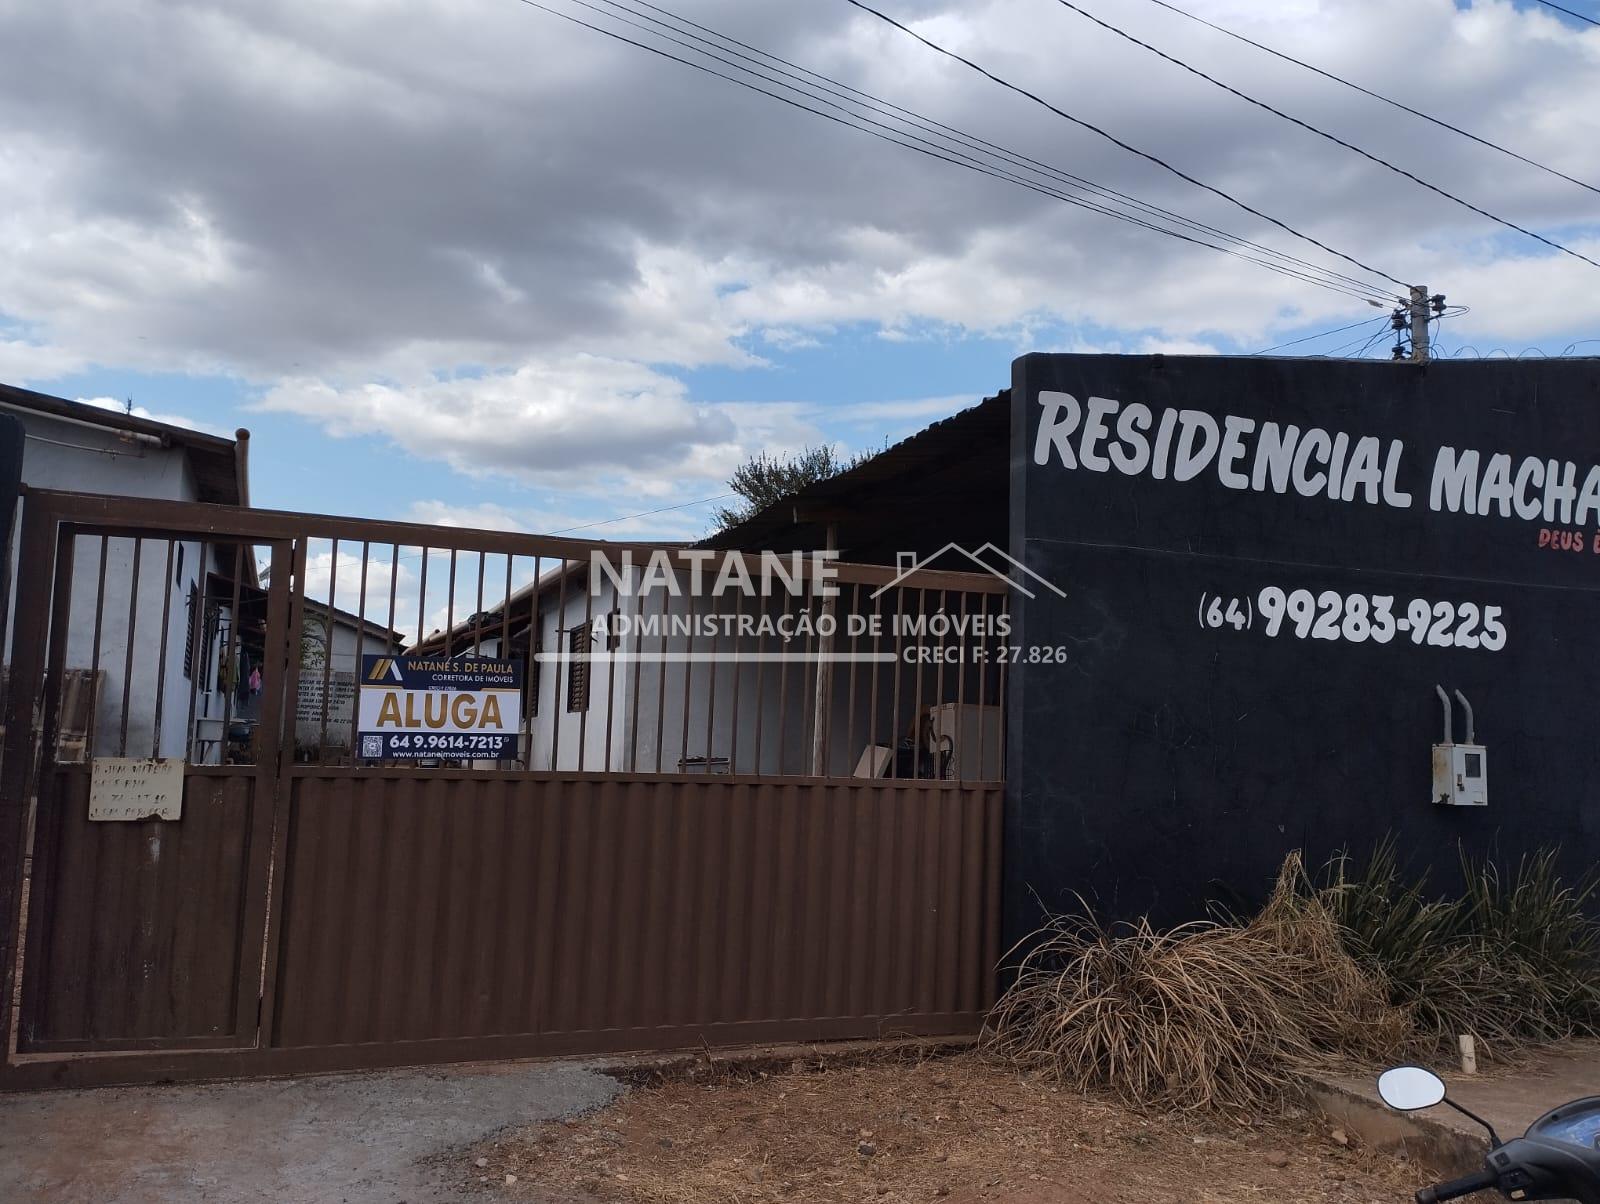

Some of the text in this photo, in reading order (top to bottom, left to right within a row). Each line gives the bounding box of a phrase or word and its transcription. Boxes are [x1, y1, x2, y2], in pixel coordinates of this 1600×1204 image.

[1034, 390, 1412, 508] RESIDENCIAL
[1538, 528, 1584, 552] DEUS
[1199, 586, 1508, 652] (64) 99283-9225
[408, 661, 513, 674] NATANE S. DE PAULA
[432, 674, 474, 682] CORRETORA
[485, 674, 514, 683] IMÓVEIS
[376, 692, 504, 729] ALUGA
[389, 735, 503, 750] 64 9.9614-7213
[392, 750, 500, 759] www.nataneimoveis.com.br
